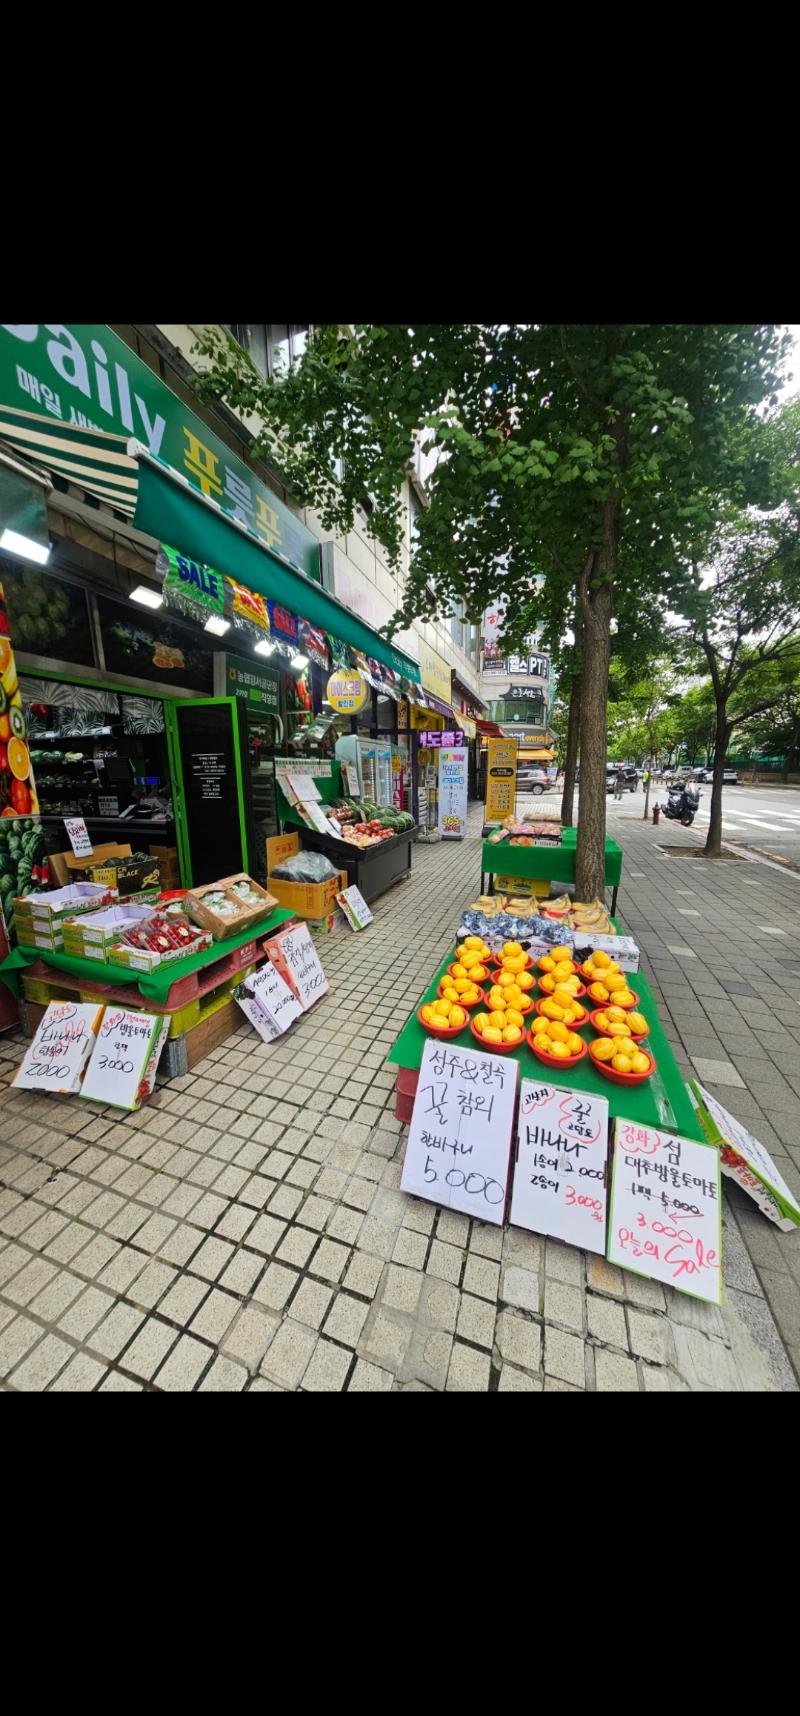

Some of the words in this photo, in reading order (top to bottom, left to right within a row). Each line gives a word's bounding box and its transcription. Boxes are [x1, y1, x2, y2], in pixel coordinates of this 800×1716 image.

[16, 364, 63, 419] 매일
[176, 554, 218, 599] SALE
[429, 1050, 506, 1089] 성주&칠곡
[420, 1082, 448, 1125] 꿀
[456, 1090, 494, 1122] 참외
[571, 1099, 592, 1124] 꿀
[420, 1130, 473, 1155] 한바구니
[526, 1125, 588, 1157] 바나나
[567, 1121, 593, 1138] 고당도
[621, 1125, 650, 1147] 강화
[663, 1140, 681, 1166] 섬
[533, 1153, 559, 1171] 1송이
[624, 1155, 718, 1200] 대추방울토마토
[530, 1174, 559, 1193] 2송이
[631, 1182, 652, 1200] 1팩
[618, 1227, 659, 1260] 오늘의
[664, 1239, 722, 1277] Sale
